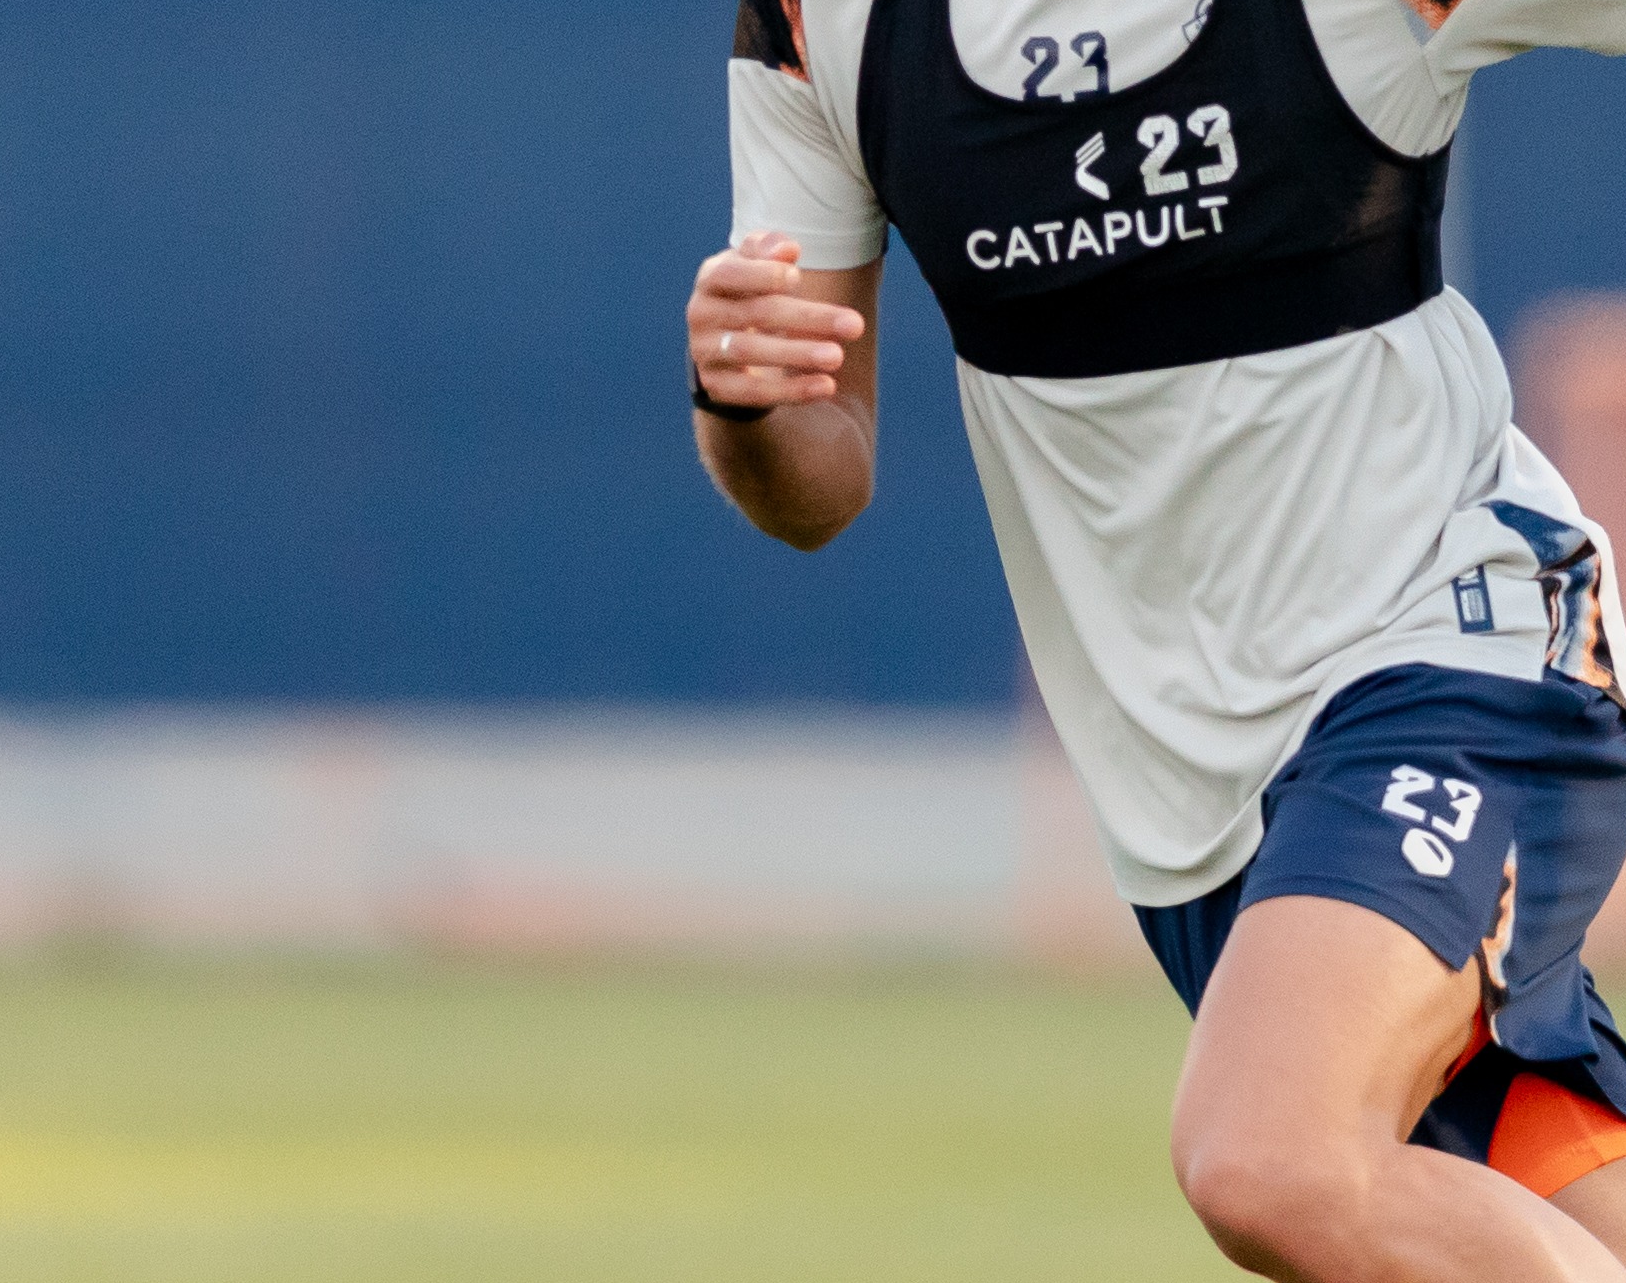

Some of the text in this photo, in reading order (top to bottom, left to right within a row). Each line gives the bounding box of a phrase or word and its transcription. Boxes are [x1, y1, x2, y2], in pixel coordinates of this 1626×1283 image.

[1020, 30, 1110, 102] 23
[1137, 103, 1238, 196] 23
[966, 196, 1229, 270] CATAPULT
[1381, 763, 1482, 842] 23
